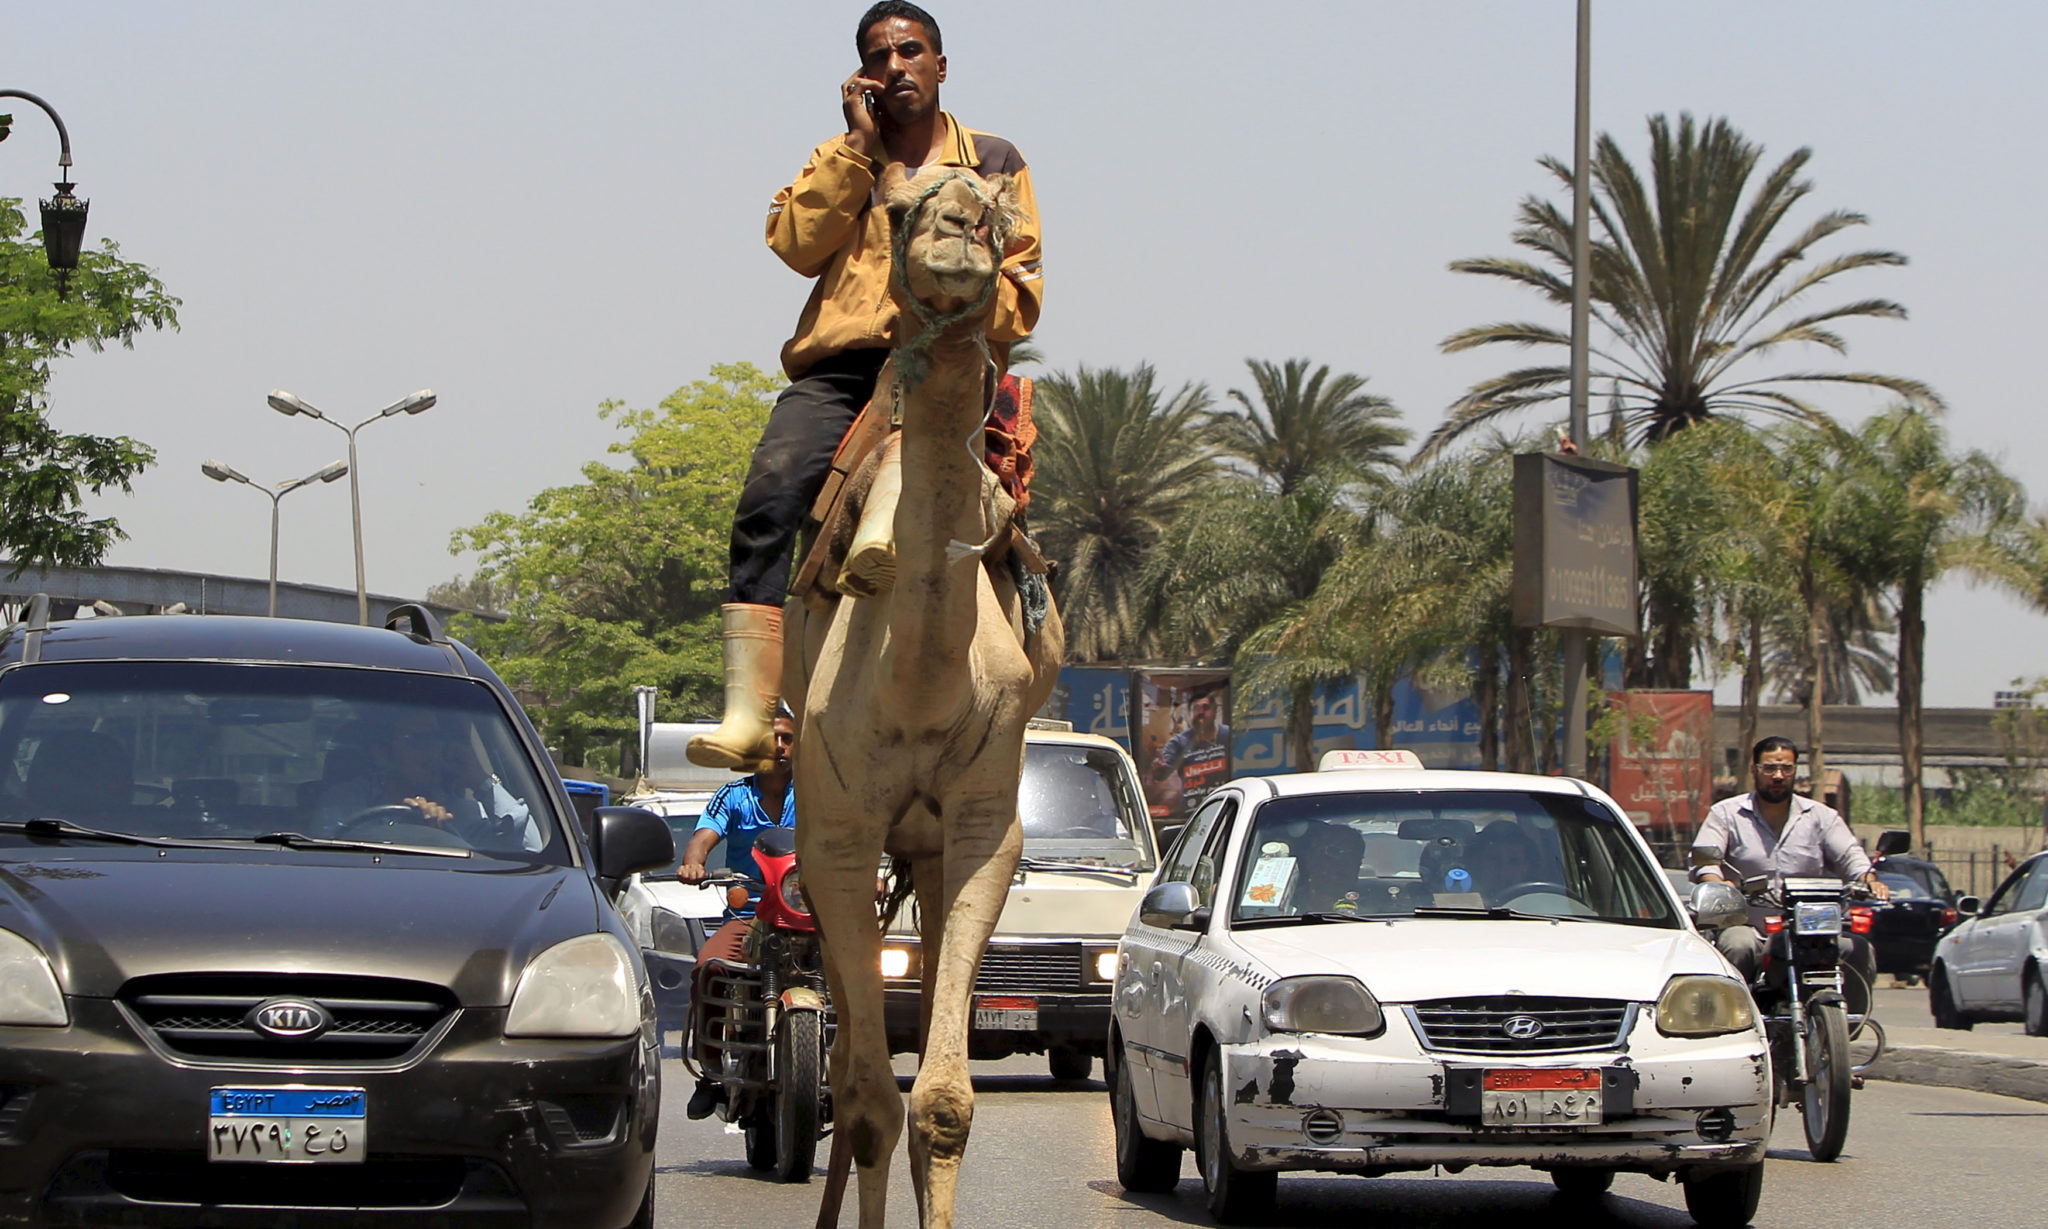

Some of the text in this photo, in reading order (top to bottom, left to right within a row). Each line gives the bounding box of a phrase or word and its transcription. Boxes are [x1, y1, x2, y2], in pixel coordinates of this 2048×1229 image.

[1337, 751, 1405, 764] TAXI
[267, 1009, 312, 1028] KIA
[1494, 1072, 1532, 1086] EGYPT
[223, 1093, 275, 1111] EGYPT
[305, 1094, 352, 1110] مصر
[213, 1122, 284, 1154] ٣٧٢٩
